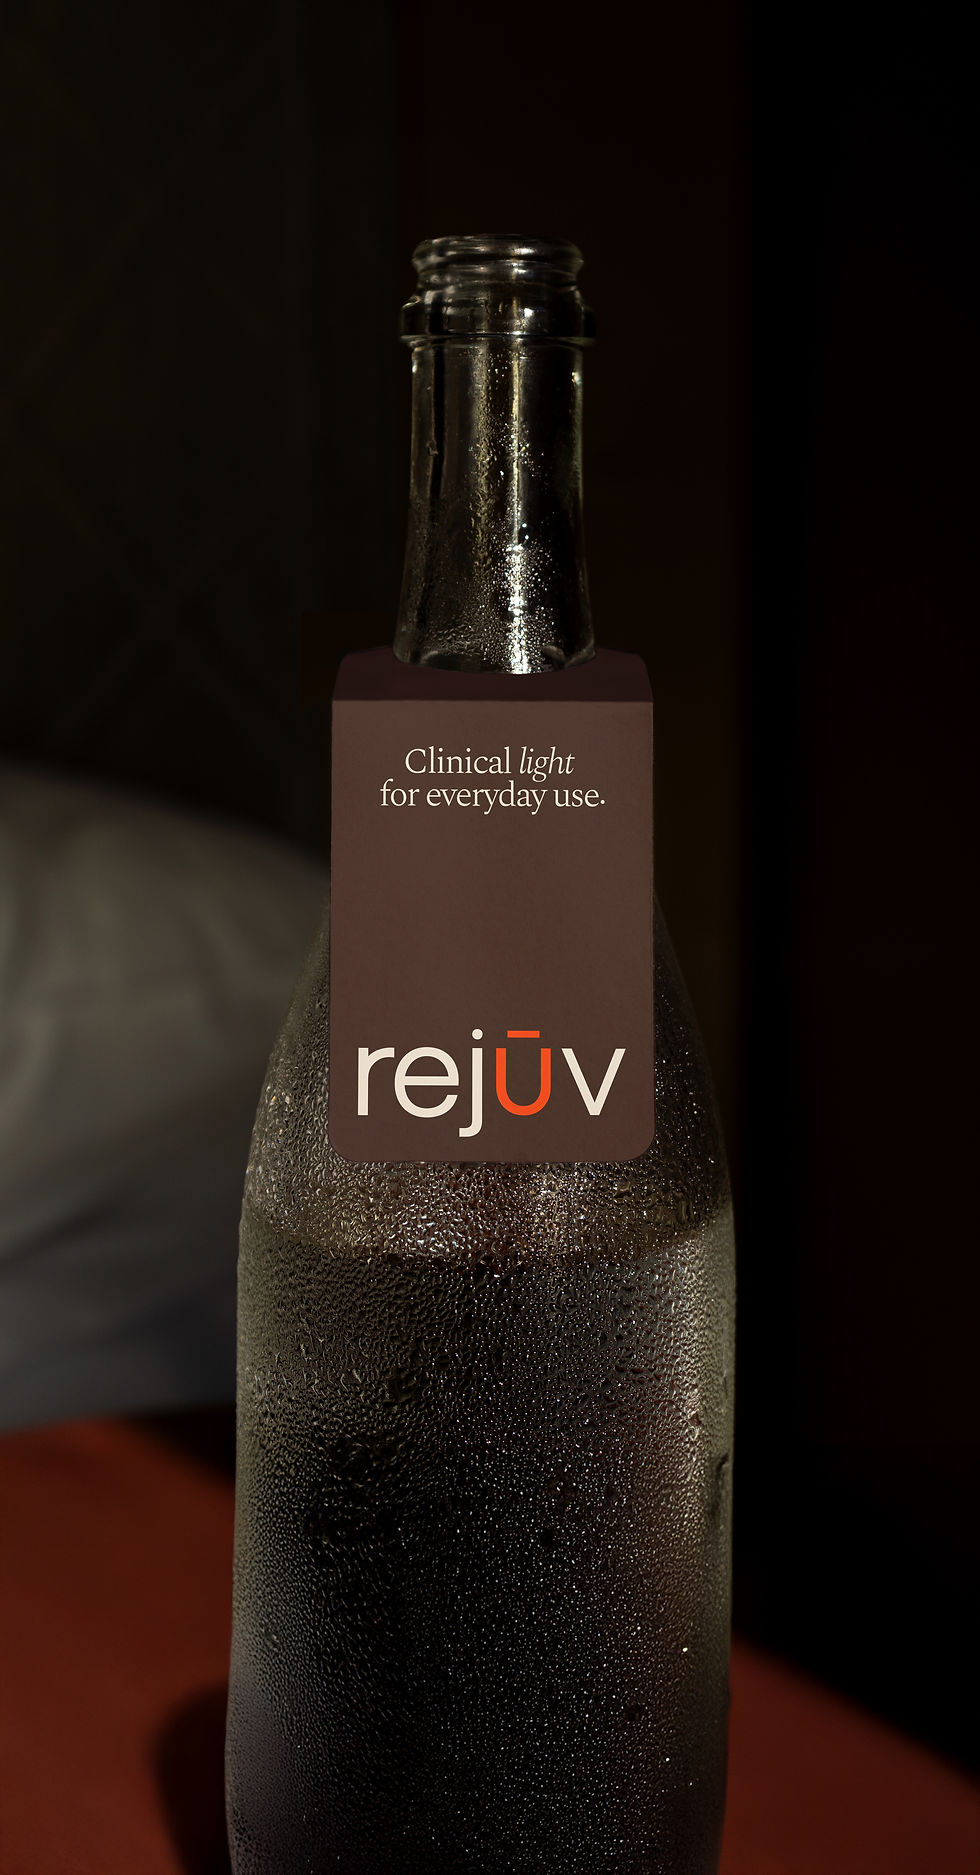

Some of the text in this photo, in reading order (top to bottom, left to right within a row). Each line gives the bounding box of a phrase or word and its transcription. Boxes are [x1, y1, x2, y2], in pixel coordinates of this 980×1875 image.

[405, 746, 576, 783] Clinical light
[380, 778, 606, 815] for everyday use.
[357, 1028, 626, 1138] rejūv
